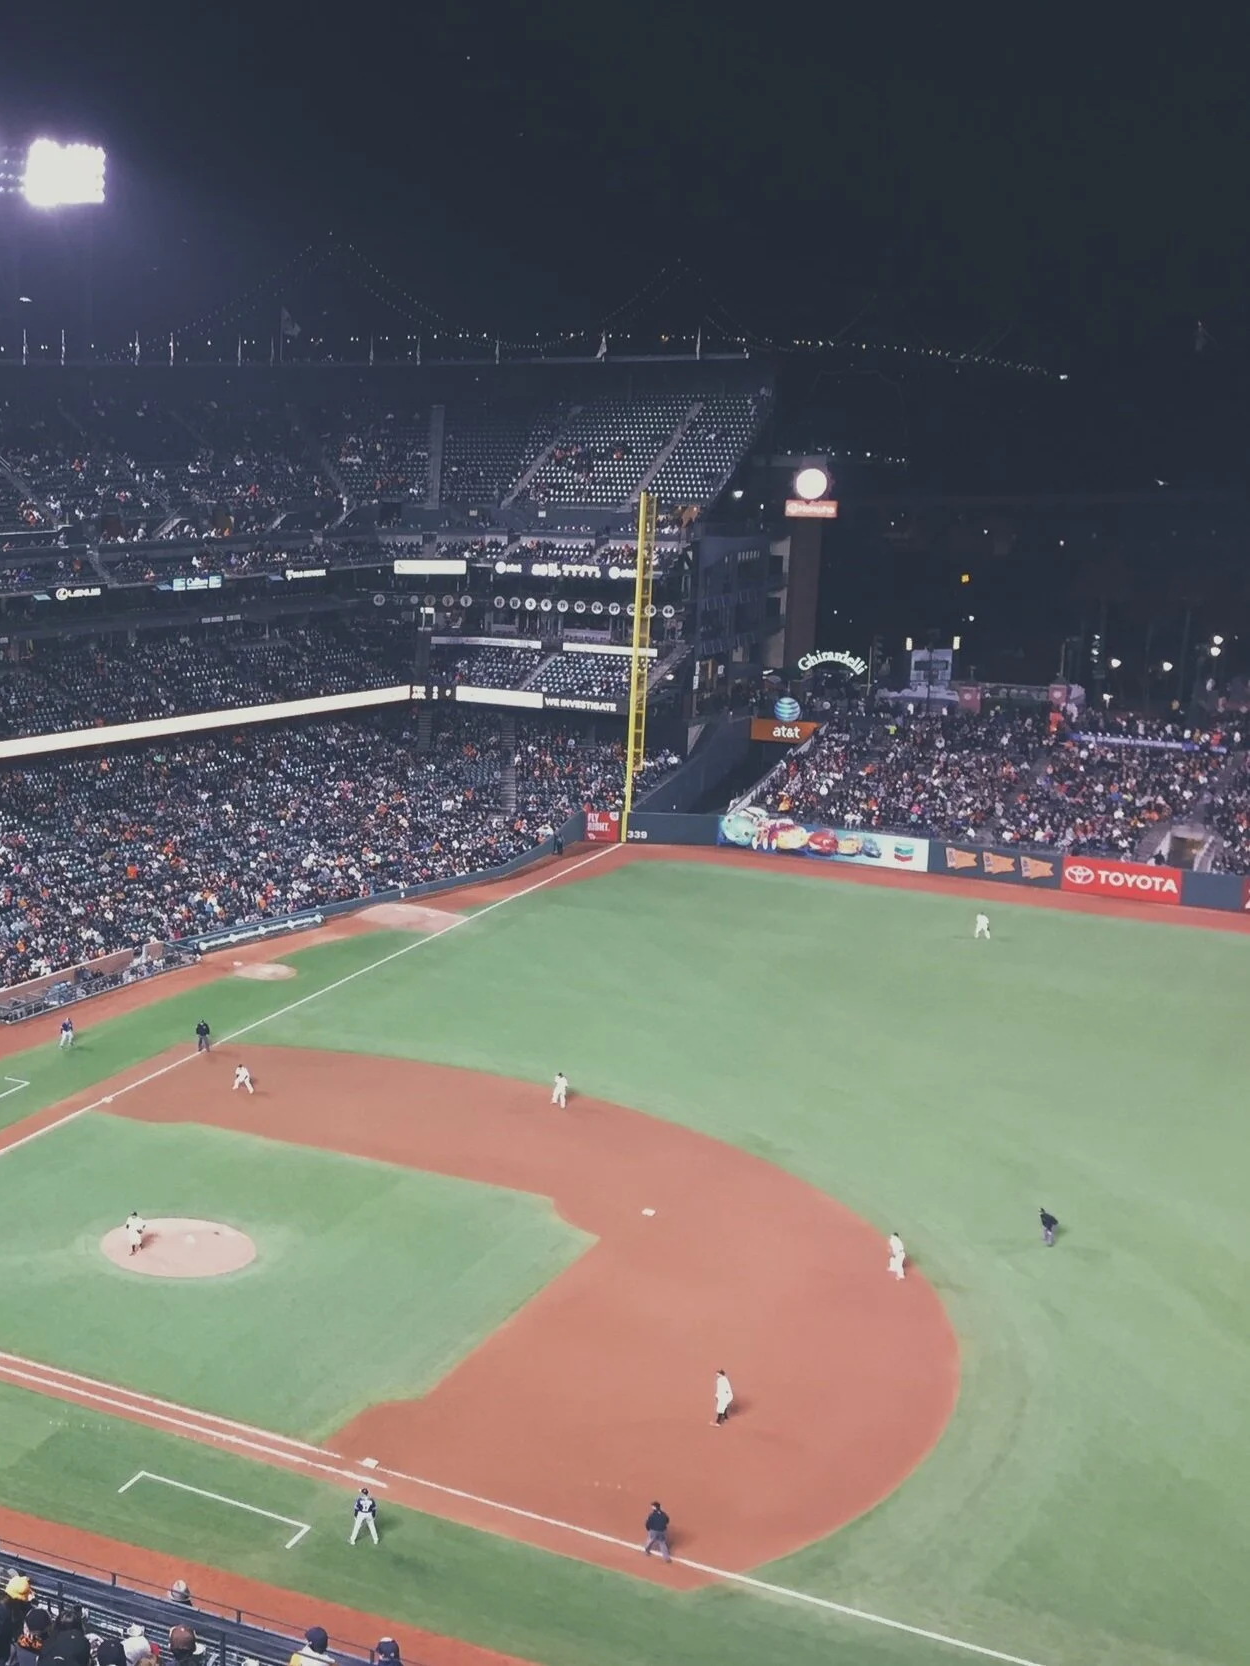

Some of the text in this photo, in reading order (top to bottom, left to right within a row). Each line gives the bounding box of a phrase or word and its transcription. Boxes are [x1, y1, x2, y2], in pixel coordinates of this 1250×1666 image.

[798, 649, 868, 676] Ghirardelli
[772, 725, 801, 739] at&t
[627, 830, 648, 839] 339
[1098, 870, 1178, 894] TOYOTA
